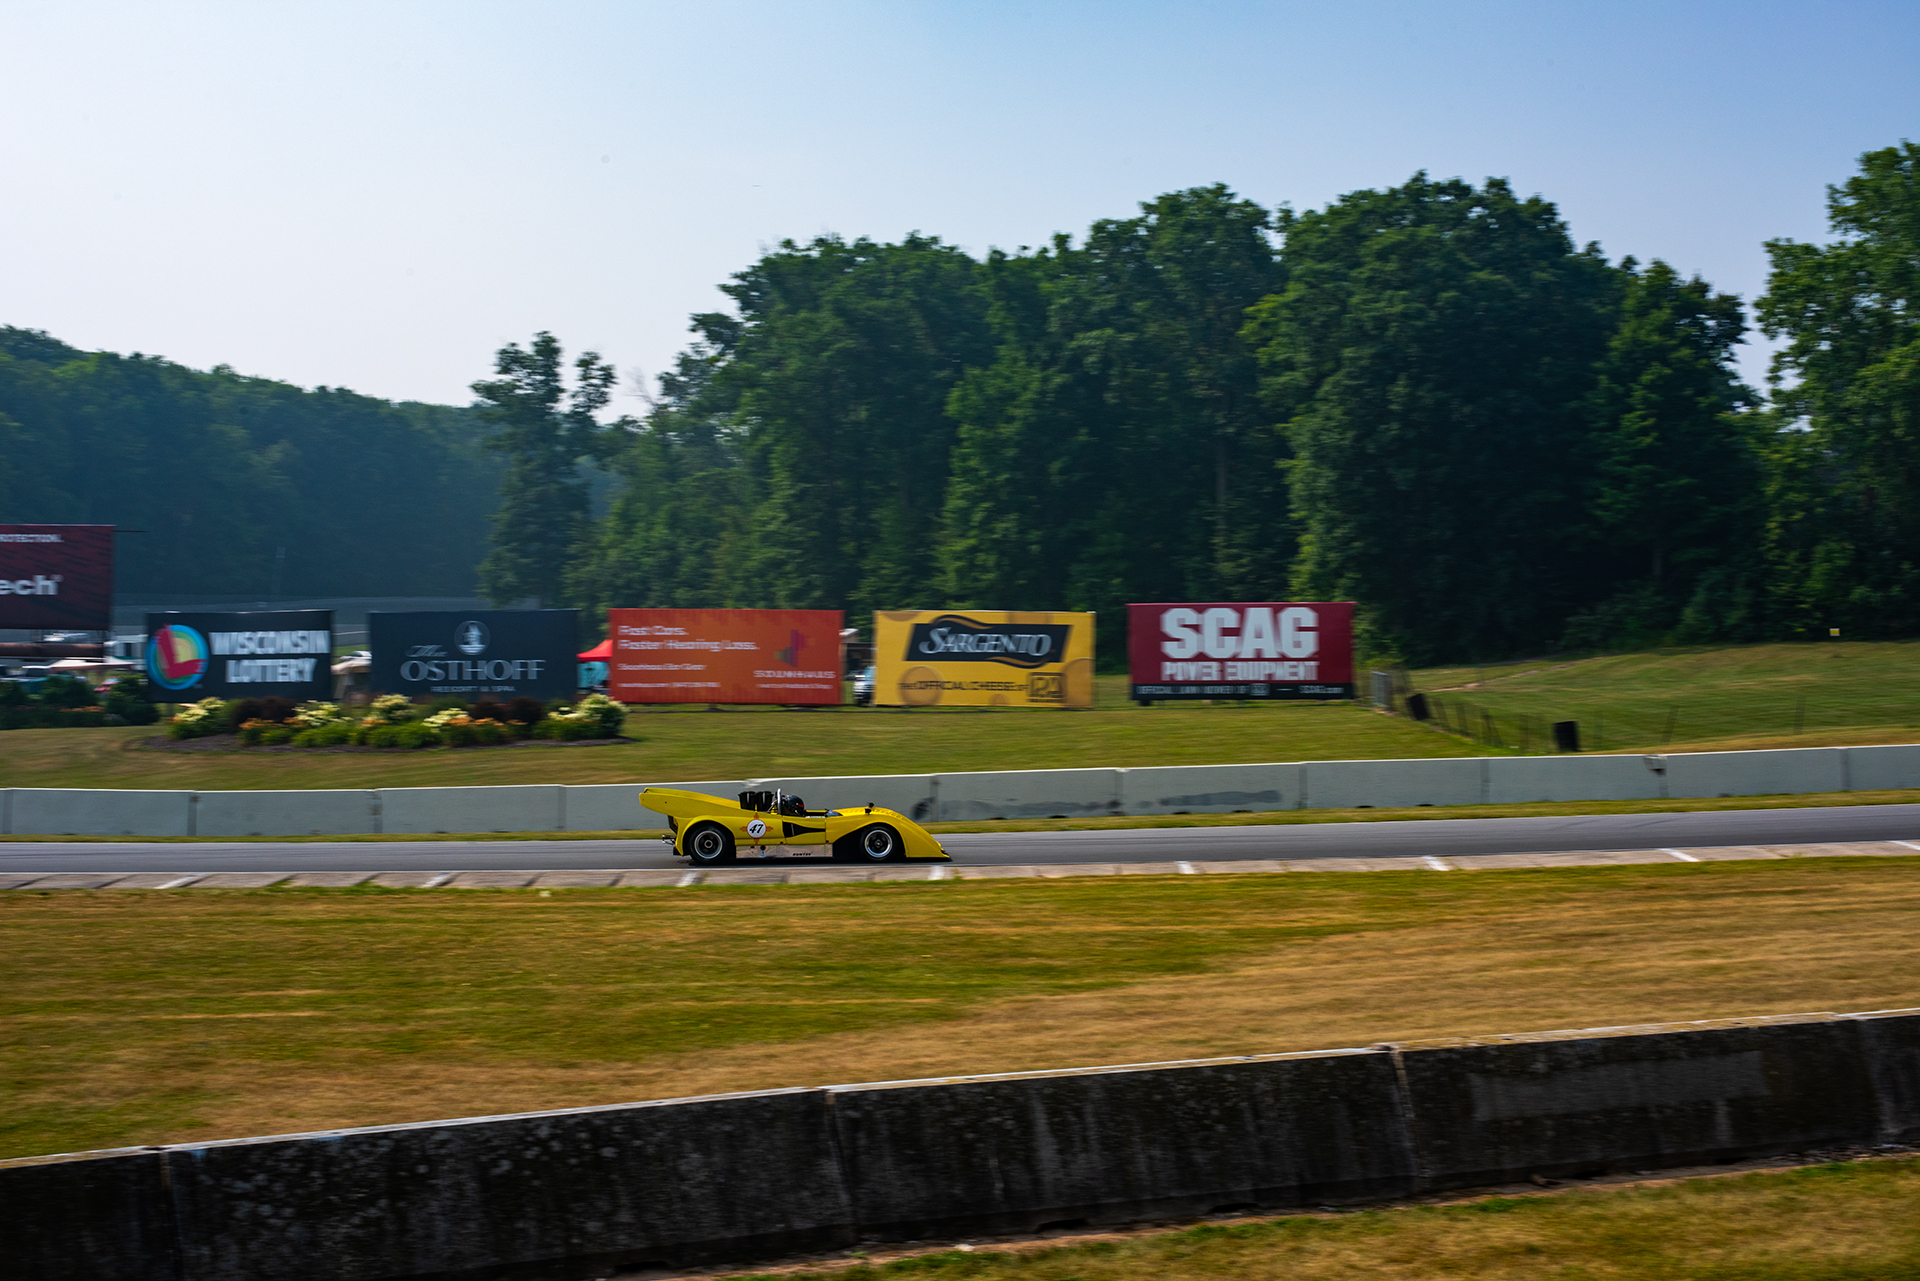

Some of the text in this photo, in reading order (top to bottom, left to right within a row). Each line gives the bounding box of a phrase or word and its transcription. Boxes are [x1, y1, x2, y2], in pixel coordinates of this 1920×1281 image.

[208, 630, 330, 655] WISCONSIN
[1160, 607, 1319, 659] SCAG
[404, 645, 448, 657] The
[225, 658, 318, 683] LOTTERY
[400, 659, 546, 681] OSTHOFF
[1161, 661, 1320, 681] POWER EQUIPMENT
[749, 824, 764, 833] 47
